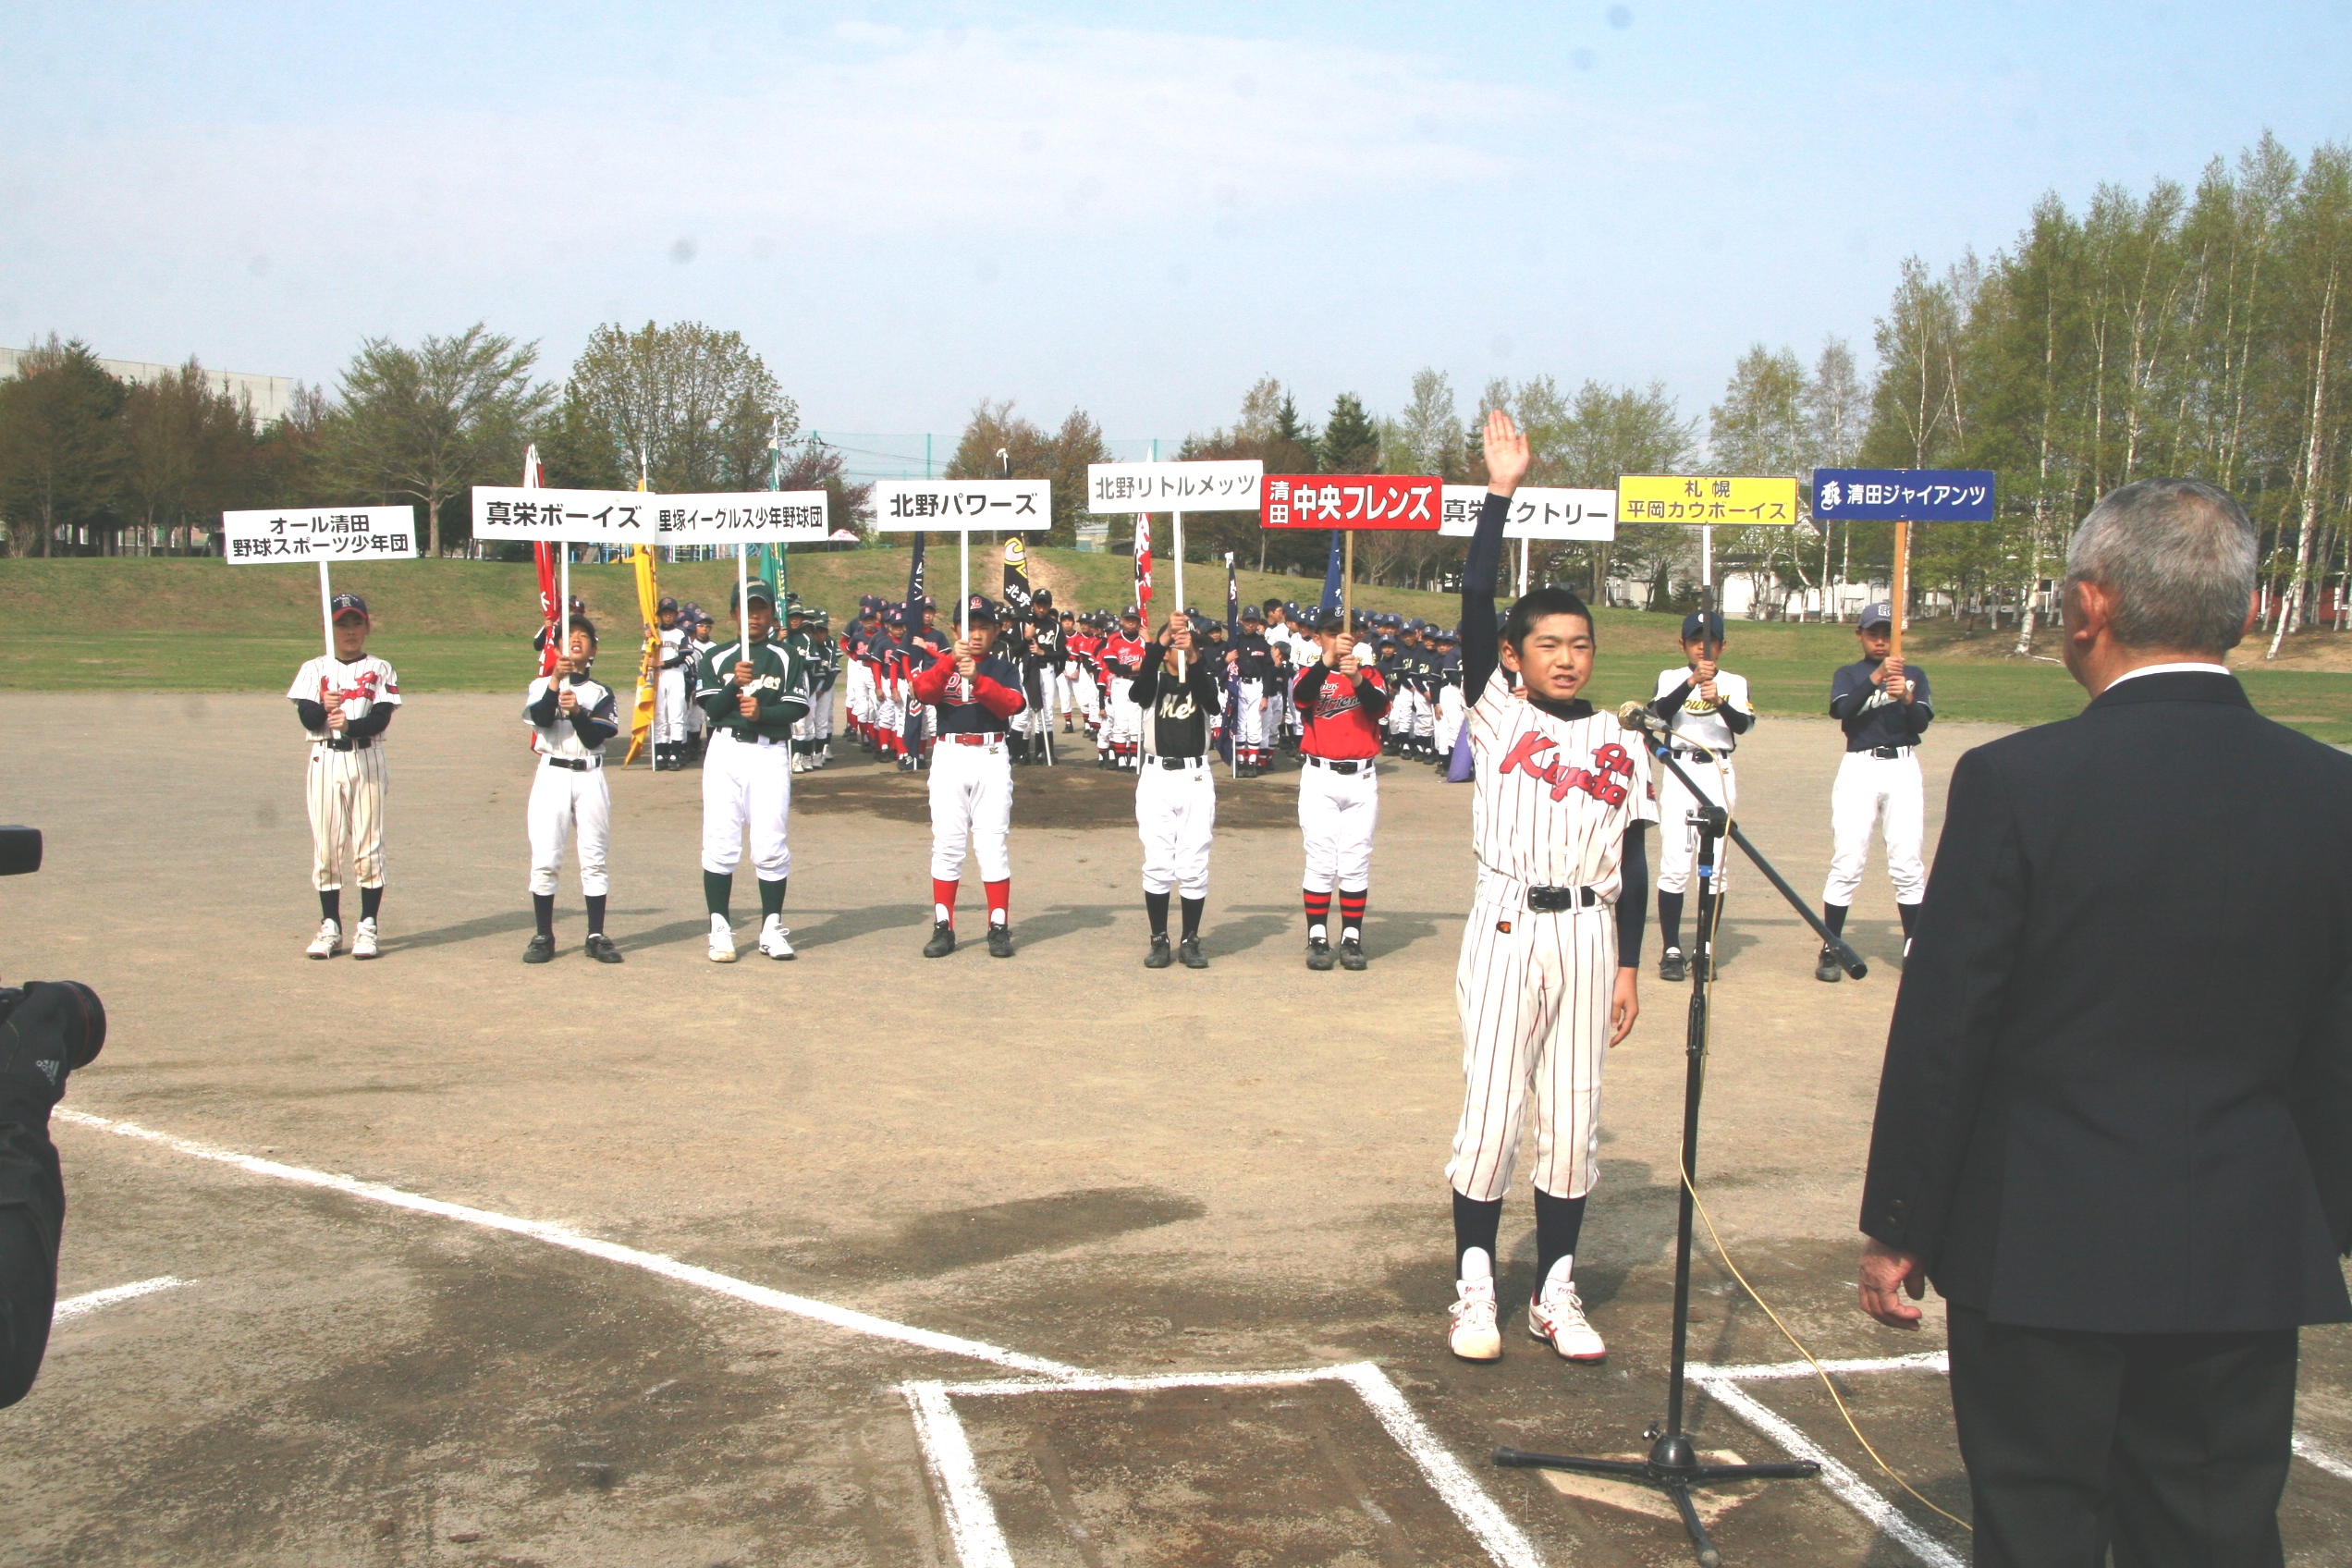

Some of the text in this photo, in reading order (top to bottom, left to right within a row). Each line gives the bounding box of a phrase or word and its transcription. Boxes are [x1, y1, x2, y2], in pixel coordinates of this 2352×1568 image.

[1095, 474, 1256, 500] 北野リトルメッツ
[1684, 480, 1731, 498] 札幌
[1846, 484, 1986, 506] 清田ジャイアンツ
[486, 500, 643, 529] 真栄ボーイズ
[889, 492, 1037, 518] 北野パワーズ
[1269, 480, 1290, 524] 清田
[1292, 483, 1433, 521] 中央フレンズ
[1443, 498, 1609, 525] 真栄クトリー
[1626, 500, 1788, 520] 平岡カウボーイズ
[270, 514, 370, 534] オール清田
[658, 505, 823, 533] 里塚イーグルス少年野球団
[233, 533, 409, 557] 野球スポーツ少年団
[1499, 730, 1628, 810] Kiyota
